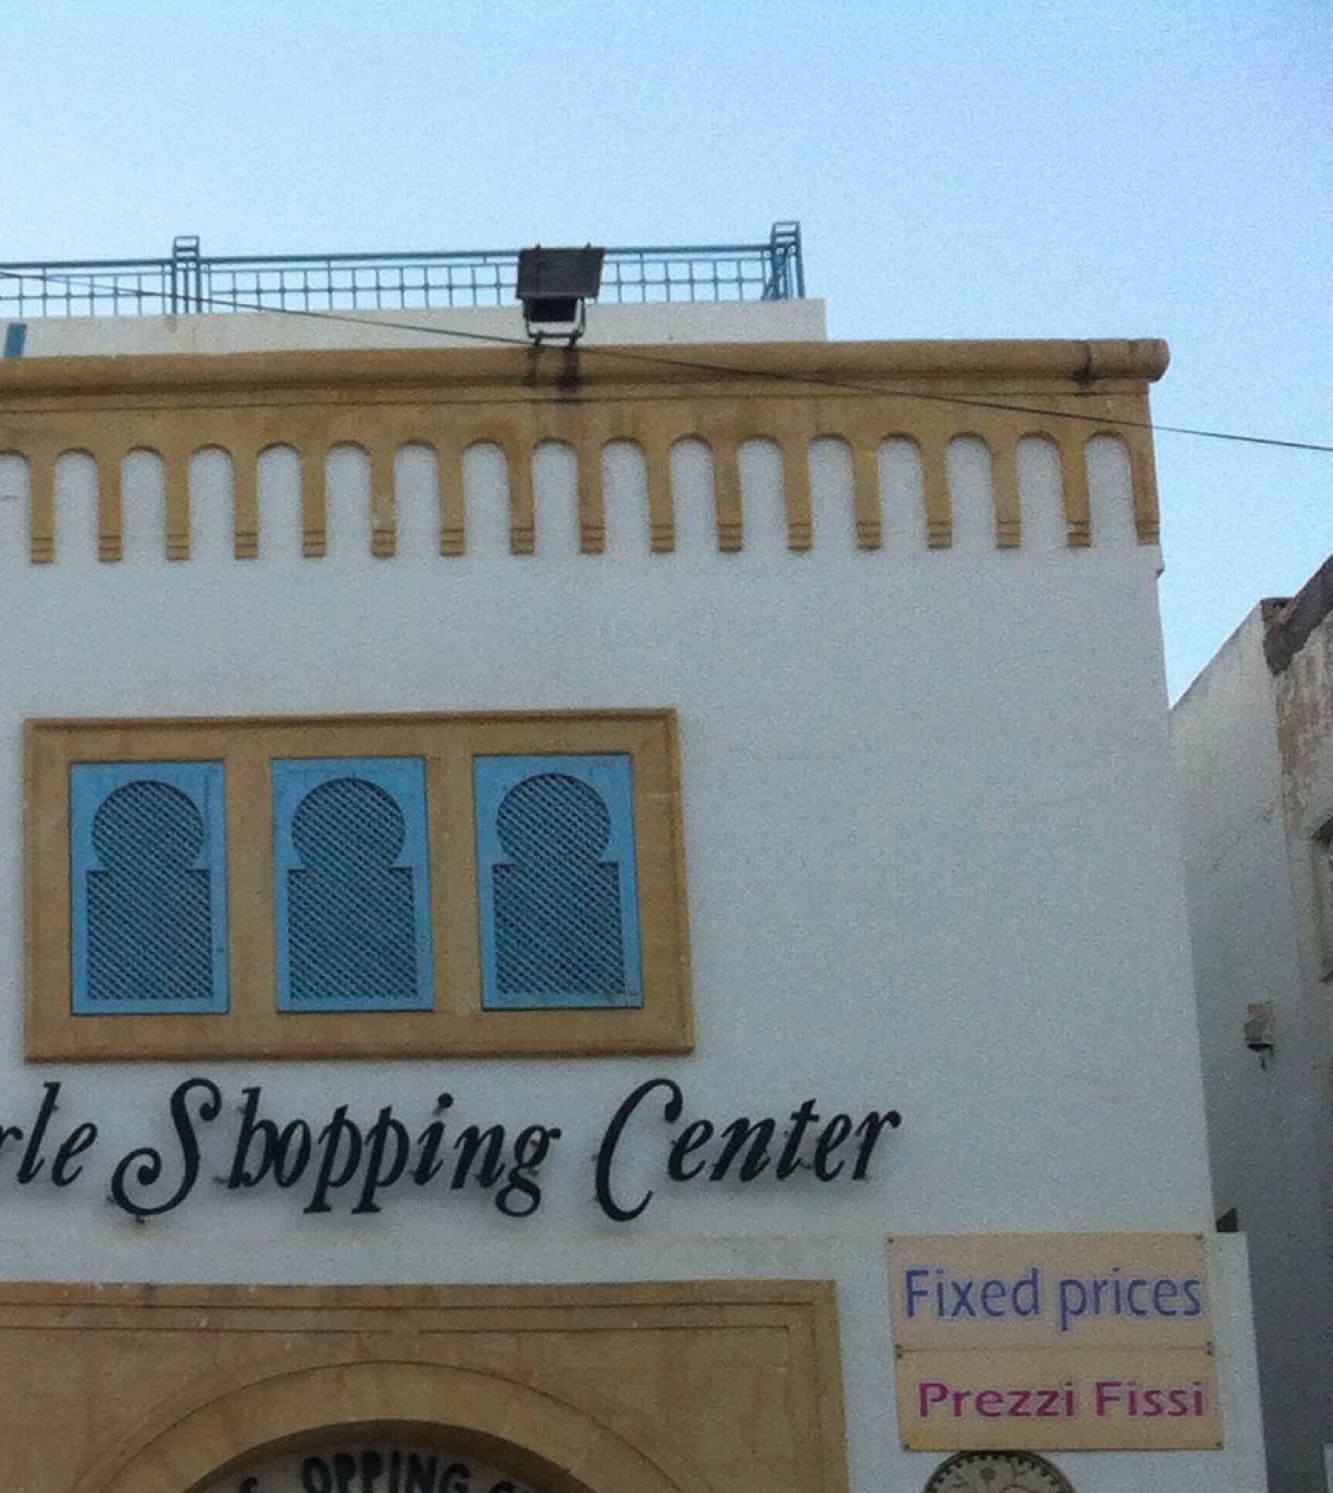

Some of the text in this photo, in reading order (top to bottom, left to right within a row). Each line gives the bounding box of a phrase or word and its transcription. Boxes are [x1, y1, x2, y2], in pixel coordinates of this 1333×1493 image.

[110, 1077, 562, 1217] Shopping
[594, 1078, 902, 1222] Center
[904, 1267, 1205, 1332] Fixed prices
[918, 1381, 1206, 1418] Prezzi Fissi
